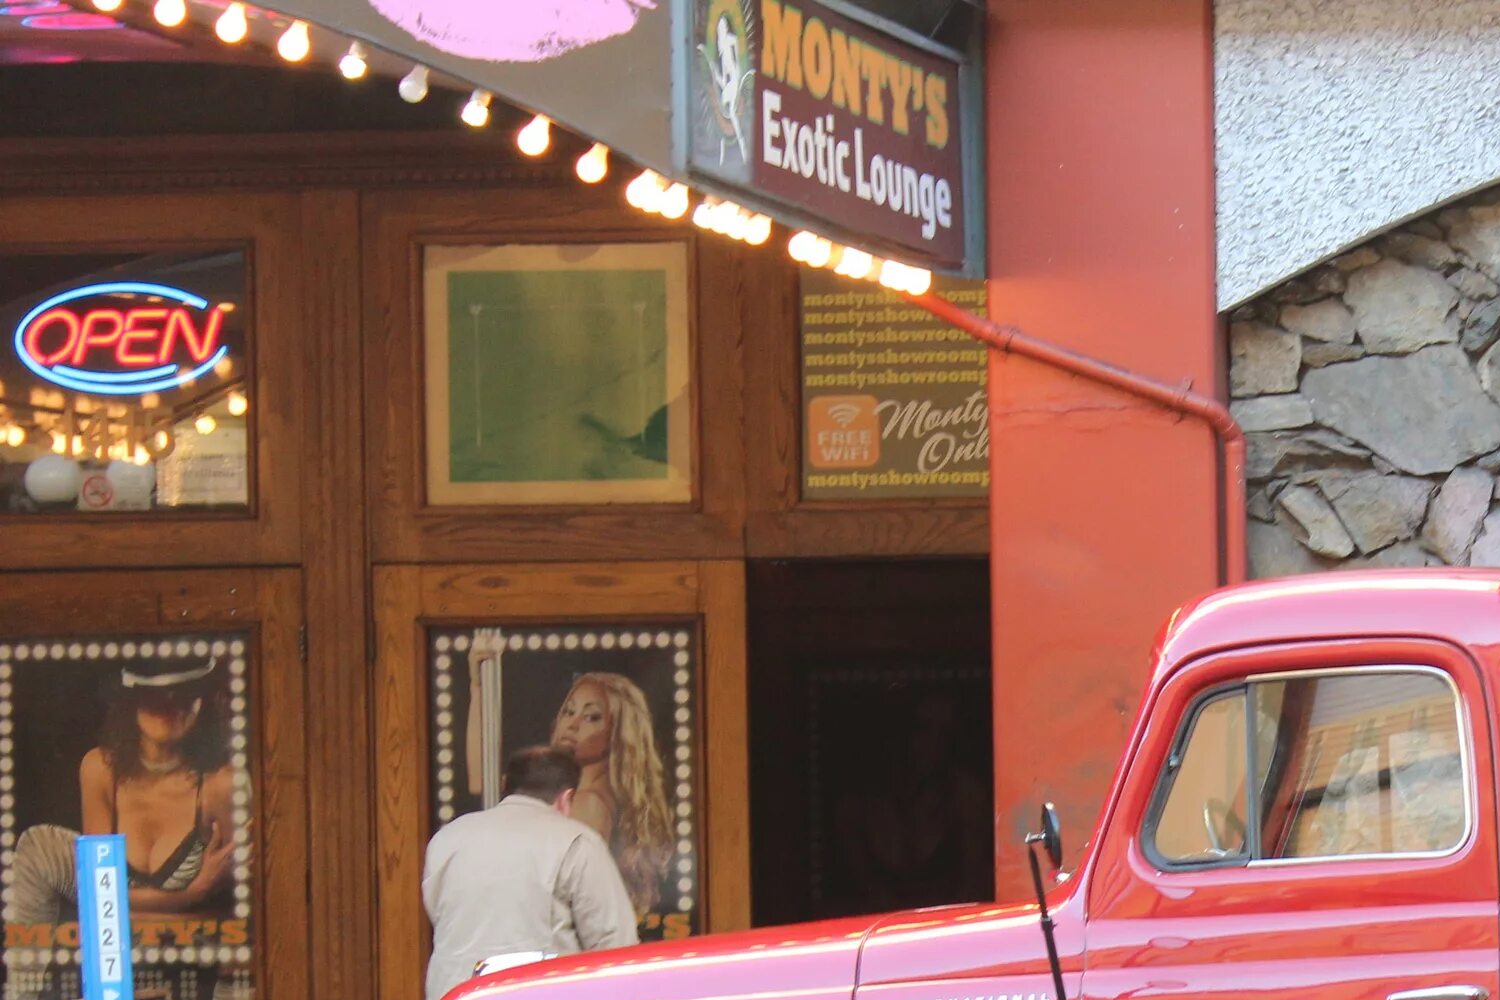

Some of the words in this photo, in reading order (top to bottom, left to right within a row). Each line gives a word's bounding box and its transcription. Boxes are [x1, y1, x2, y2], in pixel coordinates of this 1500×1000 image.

[761, 0, 949, 149] MONTY'S
[762, 89, 850, 193] Exotic
[854, 127, 952, 240] Lounge
[24, 306, 224, 366] OPEN
[817, 430, 872, 446] FREE
[97, 844, 110, 862] P
[5, 919, 248, 946] MOTY'S
